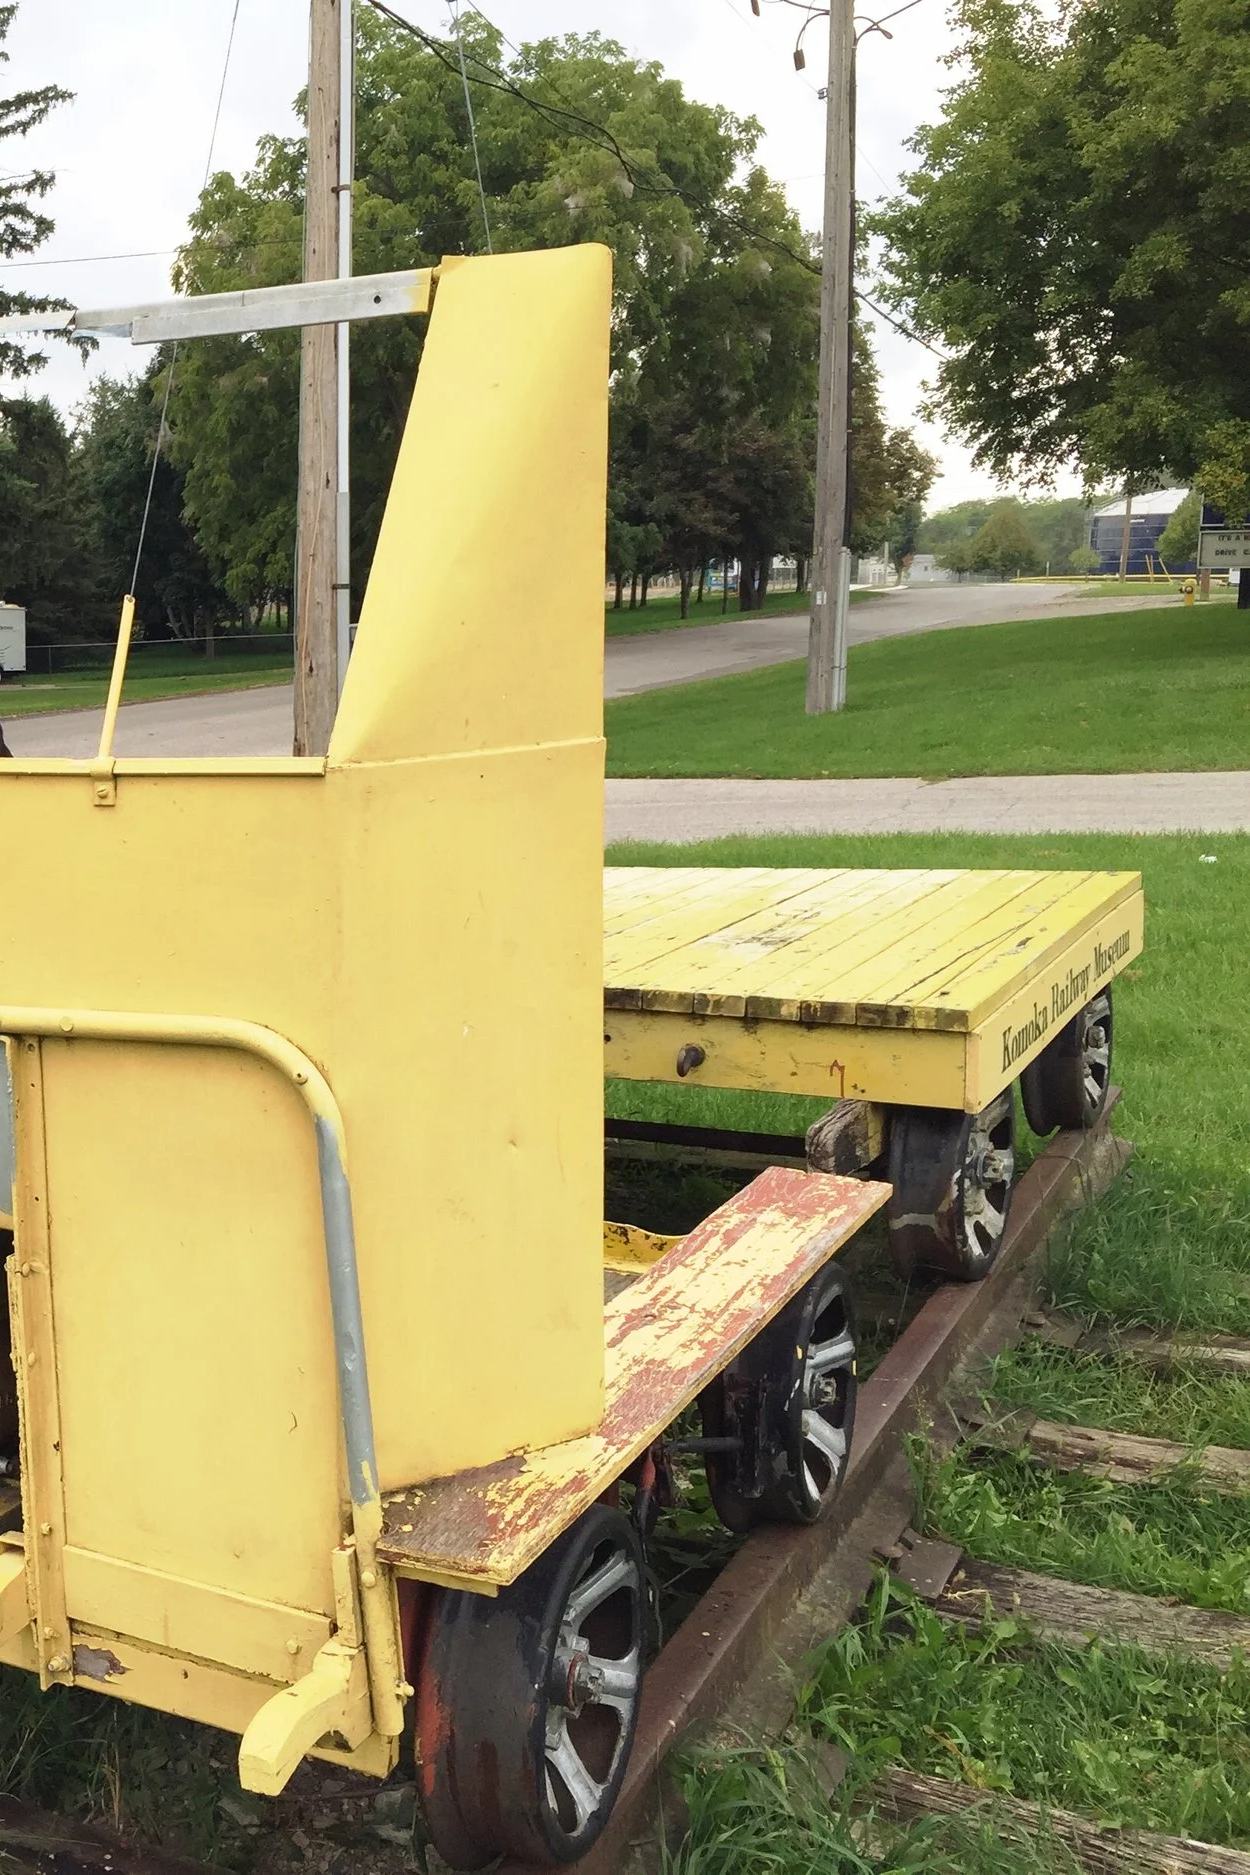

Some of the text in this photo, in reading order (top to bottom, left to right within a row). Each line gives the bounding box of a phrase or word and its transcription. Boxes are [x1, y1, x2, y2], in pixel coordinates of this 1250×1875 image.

[1001, 929, 1131, 1073] Komoka Railway Museum
